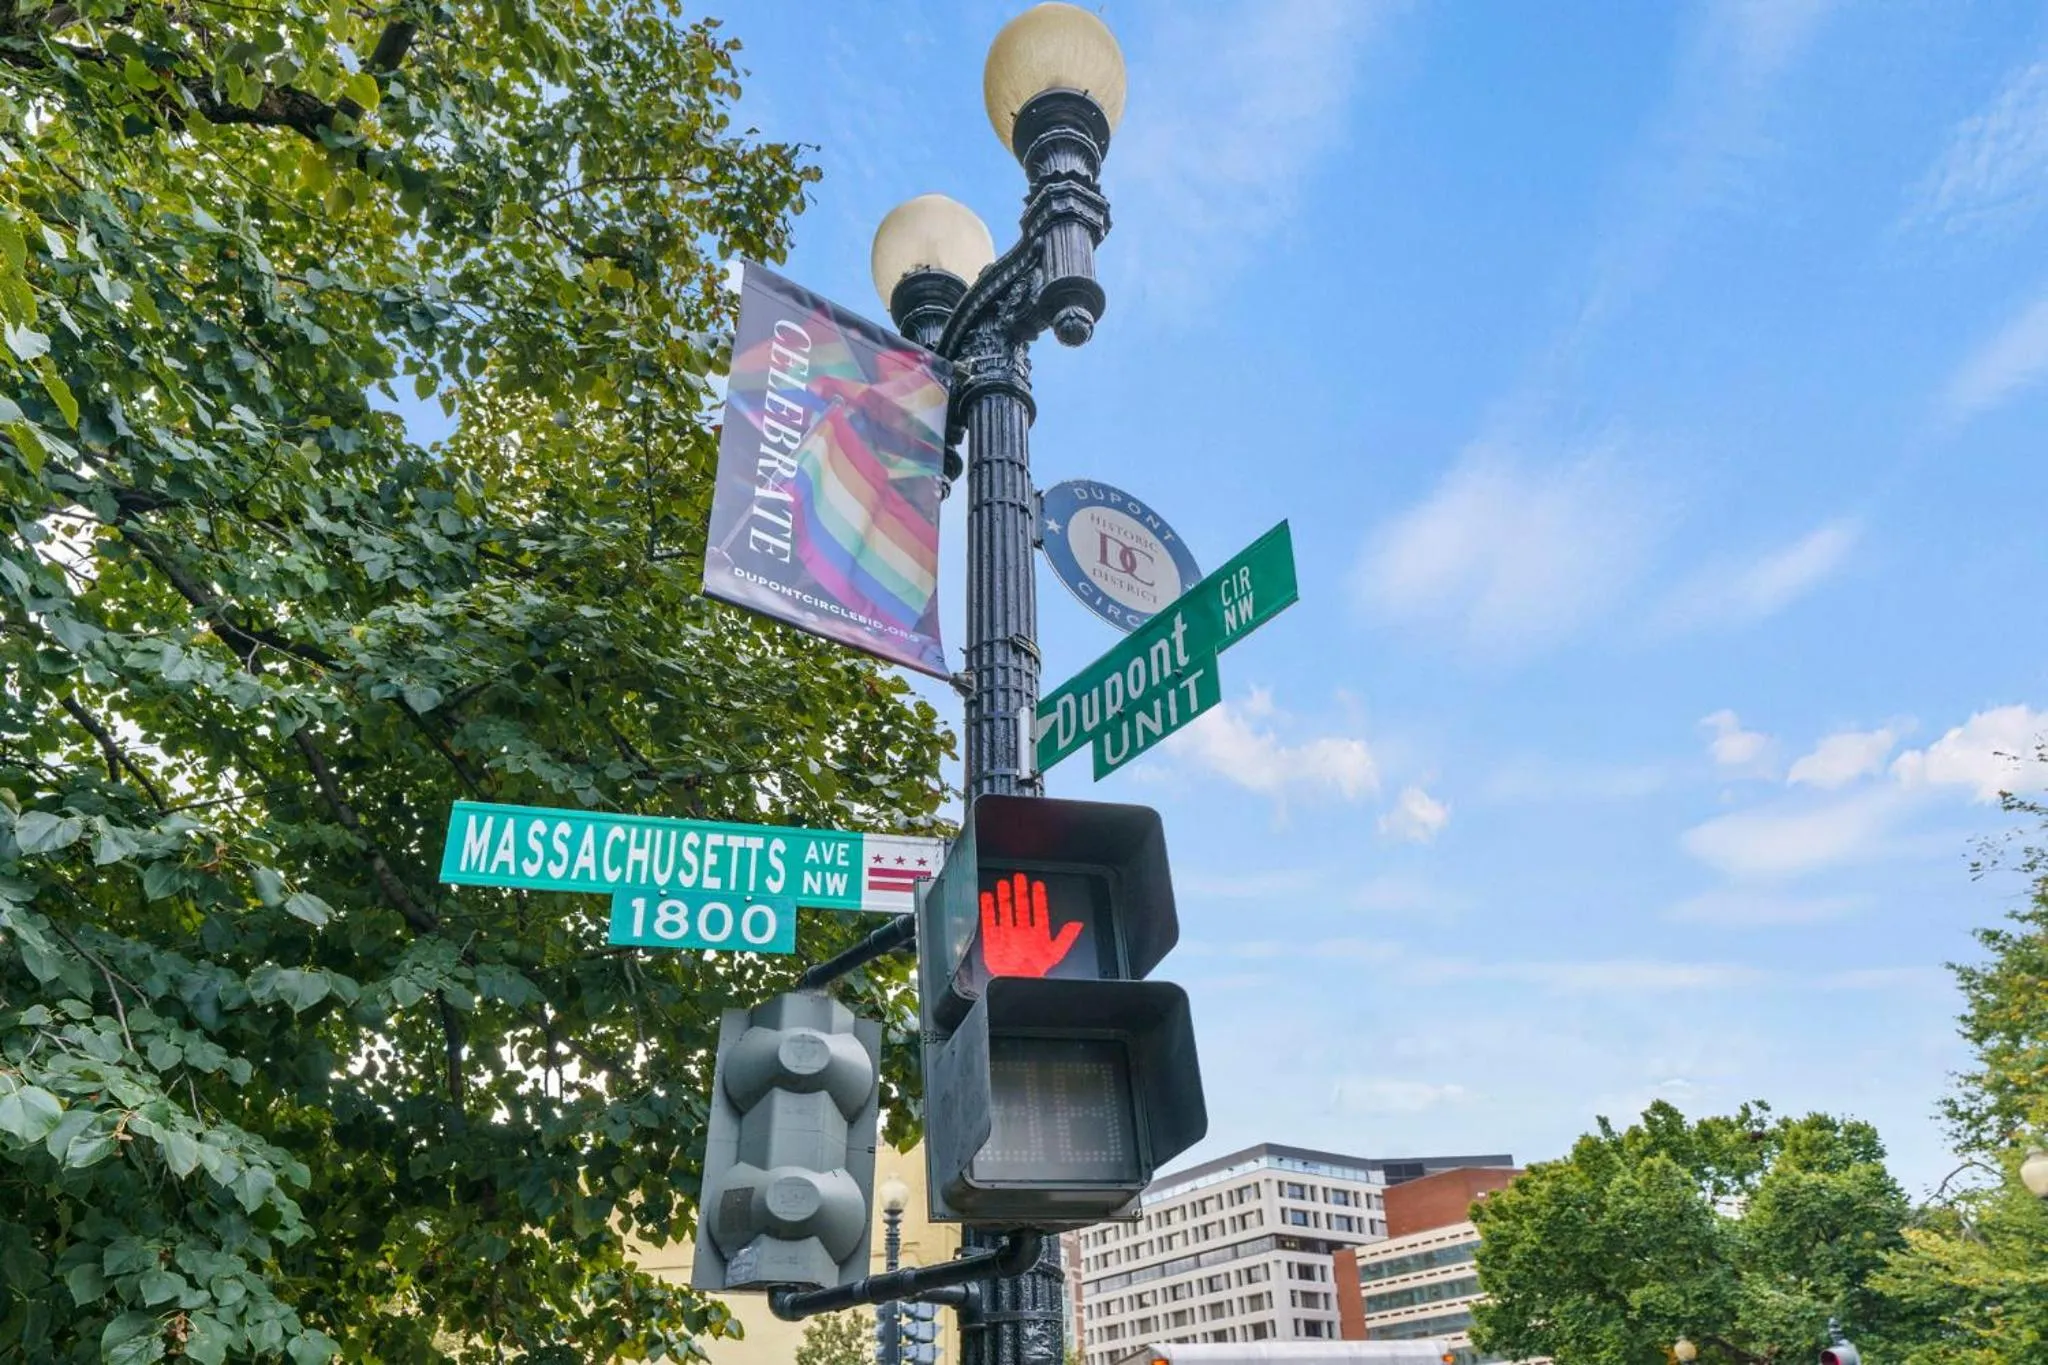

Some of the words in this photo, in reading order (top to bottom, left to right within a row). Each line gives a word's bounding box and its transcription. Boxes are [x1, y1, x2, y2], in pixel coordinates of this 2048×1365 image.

[749, 319, 812, 564] CELEBRATE
[1073, 487, 1174, 541] DUPONT
[1090, 512, 1159, 550] HISTORIC
[733, 567, 920, 643] DUPONTCIRCLEBID.ORG
[1077, 581, 1148, 627] CIRC
[1091, 567, 1159, 603] DISTRICT
[1221, 565, 1250, 607] CIR
[1223, 592, 1255, 637] NW
[1056, 611, 1190, 752] Dupont
[1103, 669, 1204, 766] UNIT
[459, 814, 787, 895] MASSACHUSETTS
[803, 841, 850, 867] AVE
[803, 871, 848, 897] NW
[631, 897, 778, 945] 1800
